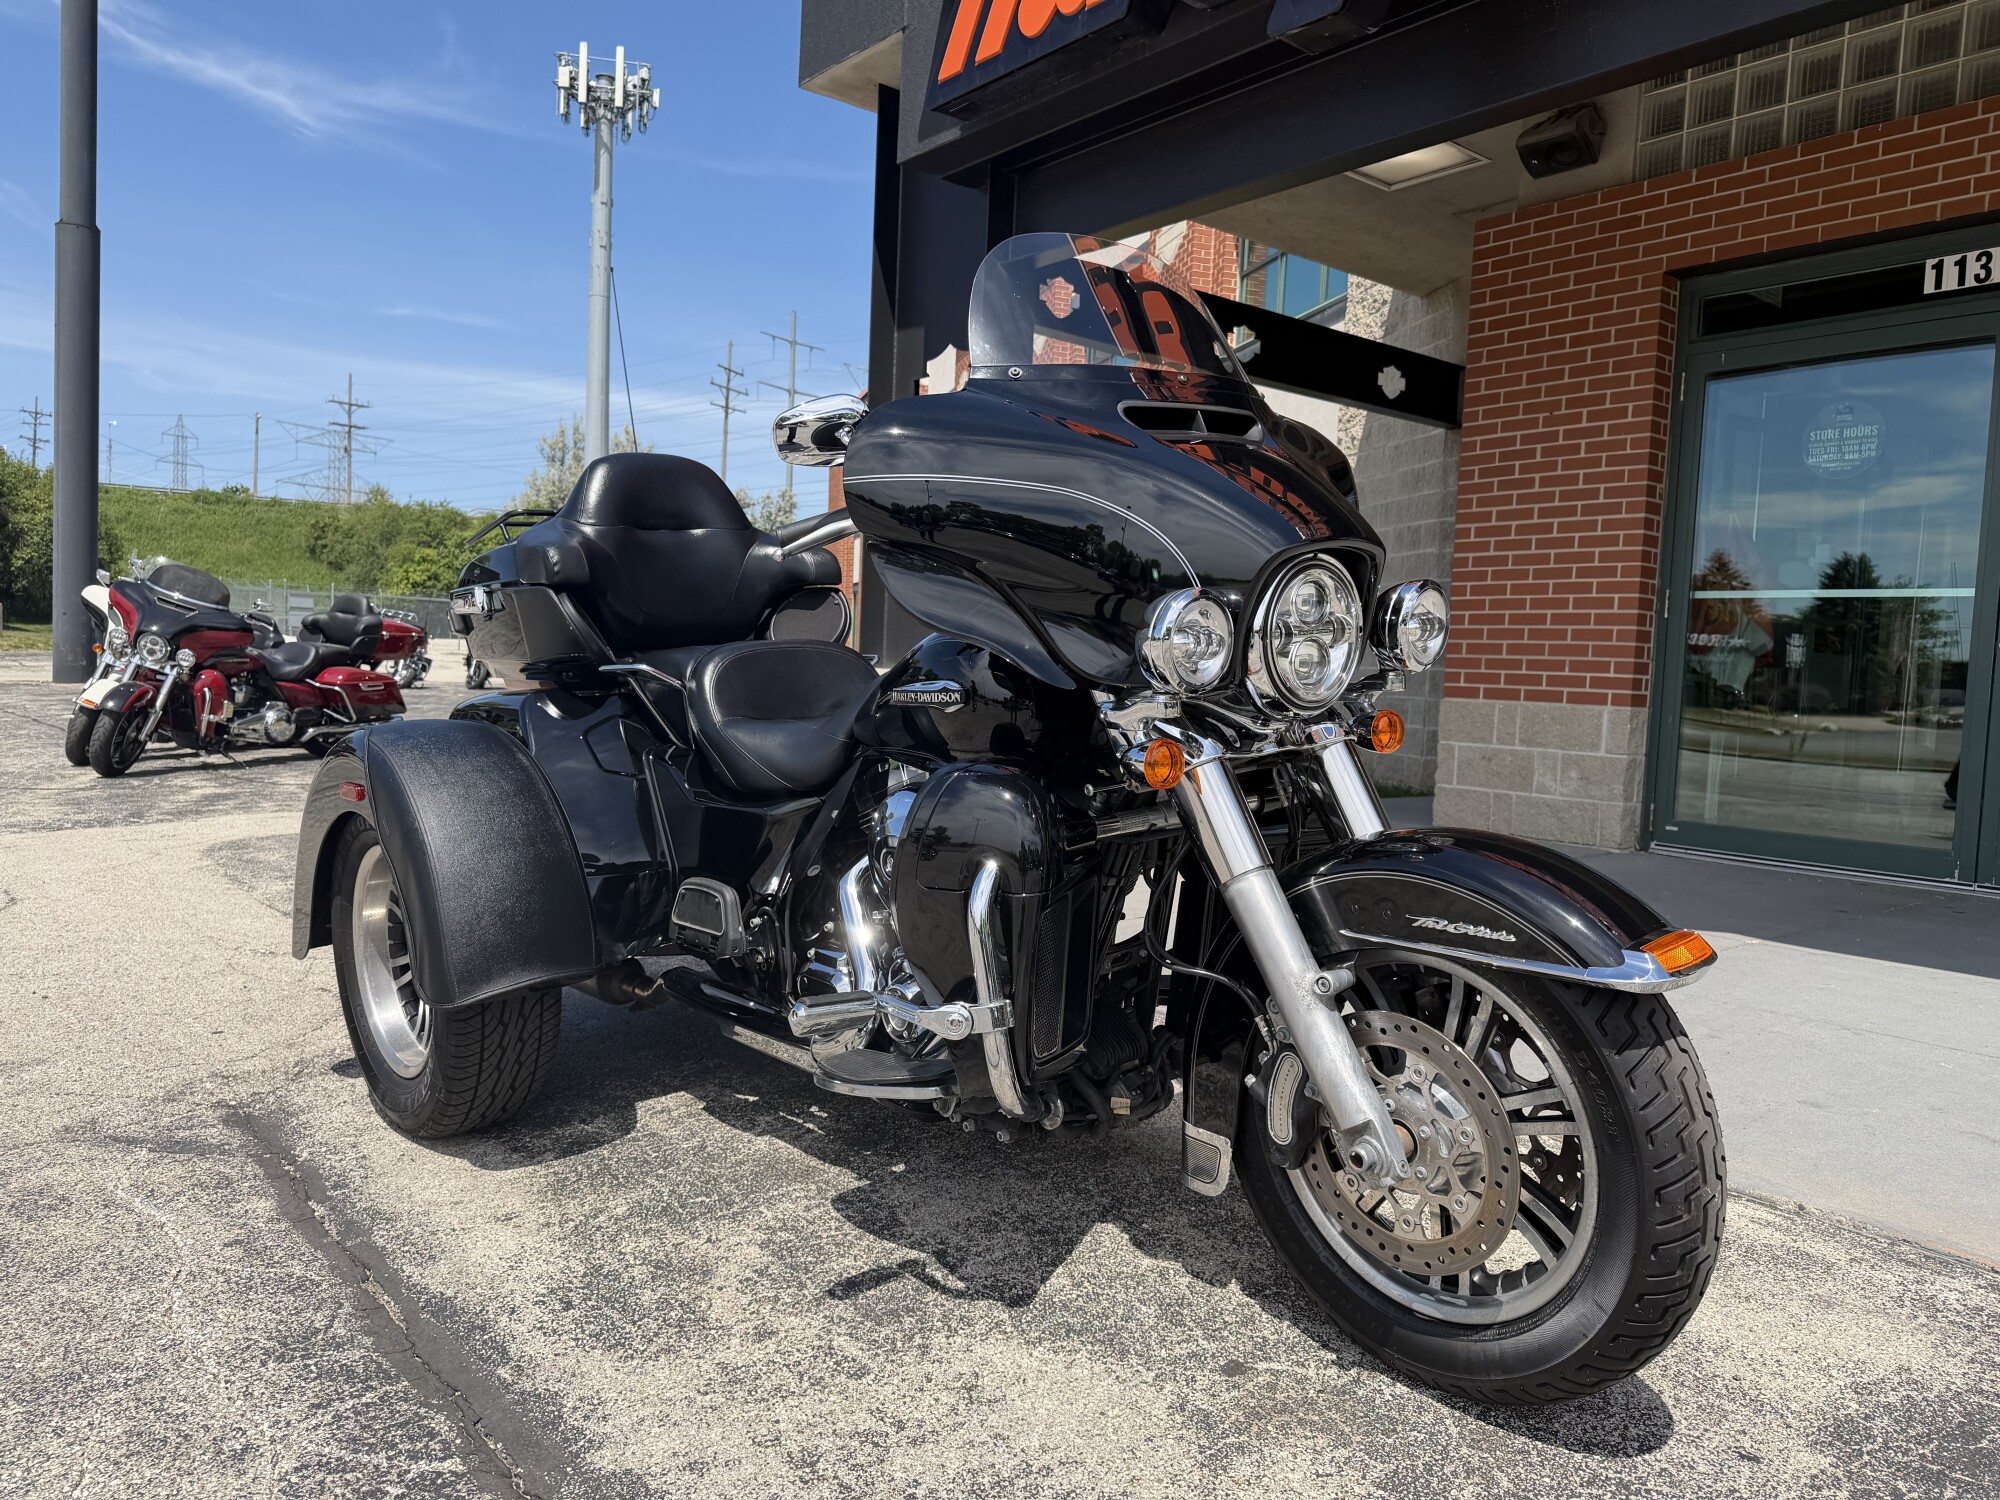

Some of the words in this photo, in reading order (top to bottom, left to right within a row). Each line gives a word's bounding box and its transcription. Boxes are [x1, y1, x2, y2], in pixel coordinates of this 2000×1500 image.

[1931, 250, 1993, 291] 113
[1810, 428, 1840, 441] STORE
[1843, 424, 1878, 438] HOURS
[892, 691, 962, 703] HARLEY-DAVIDSON
